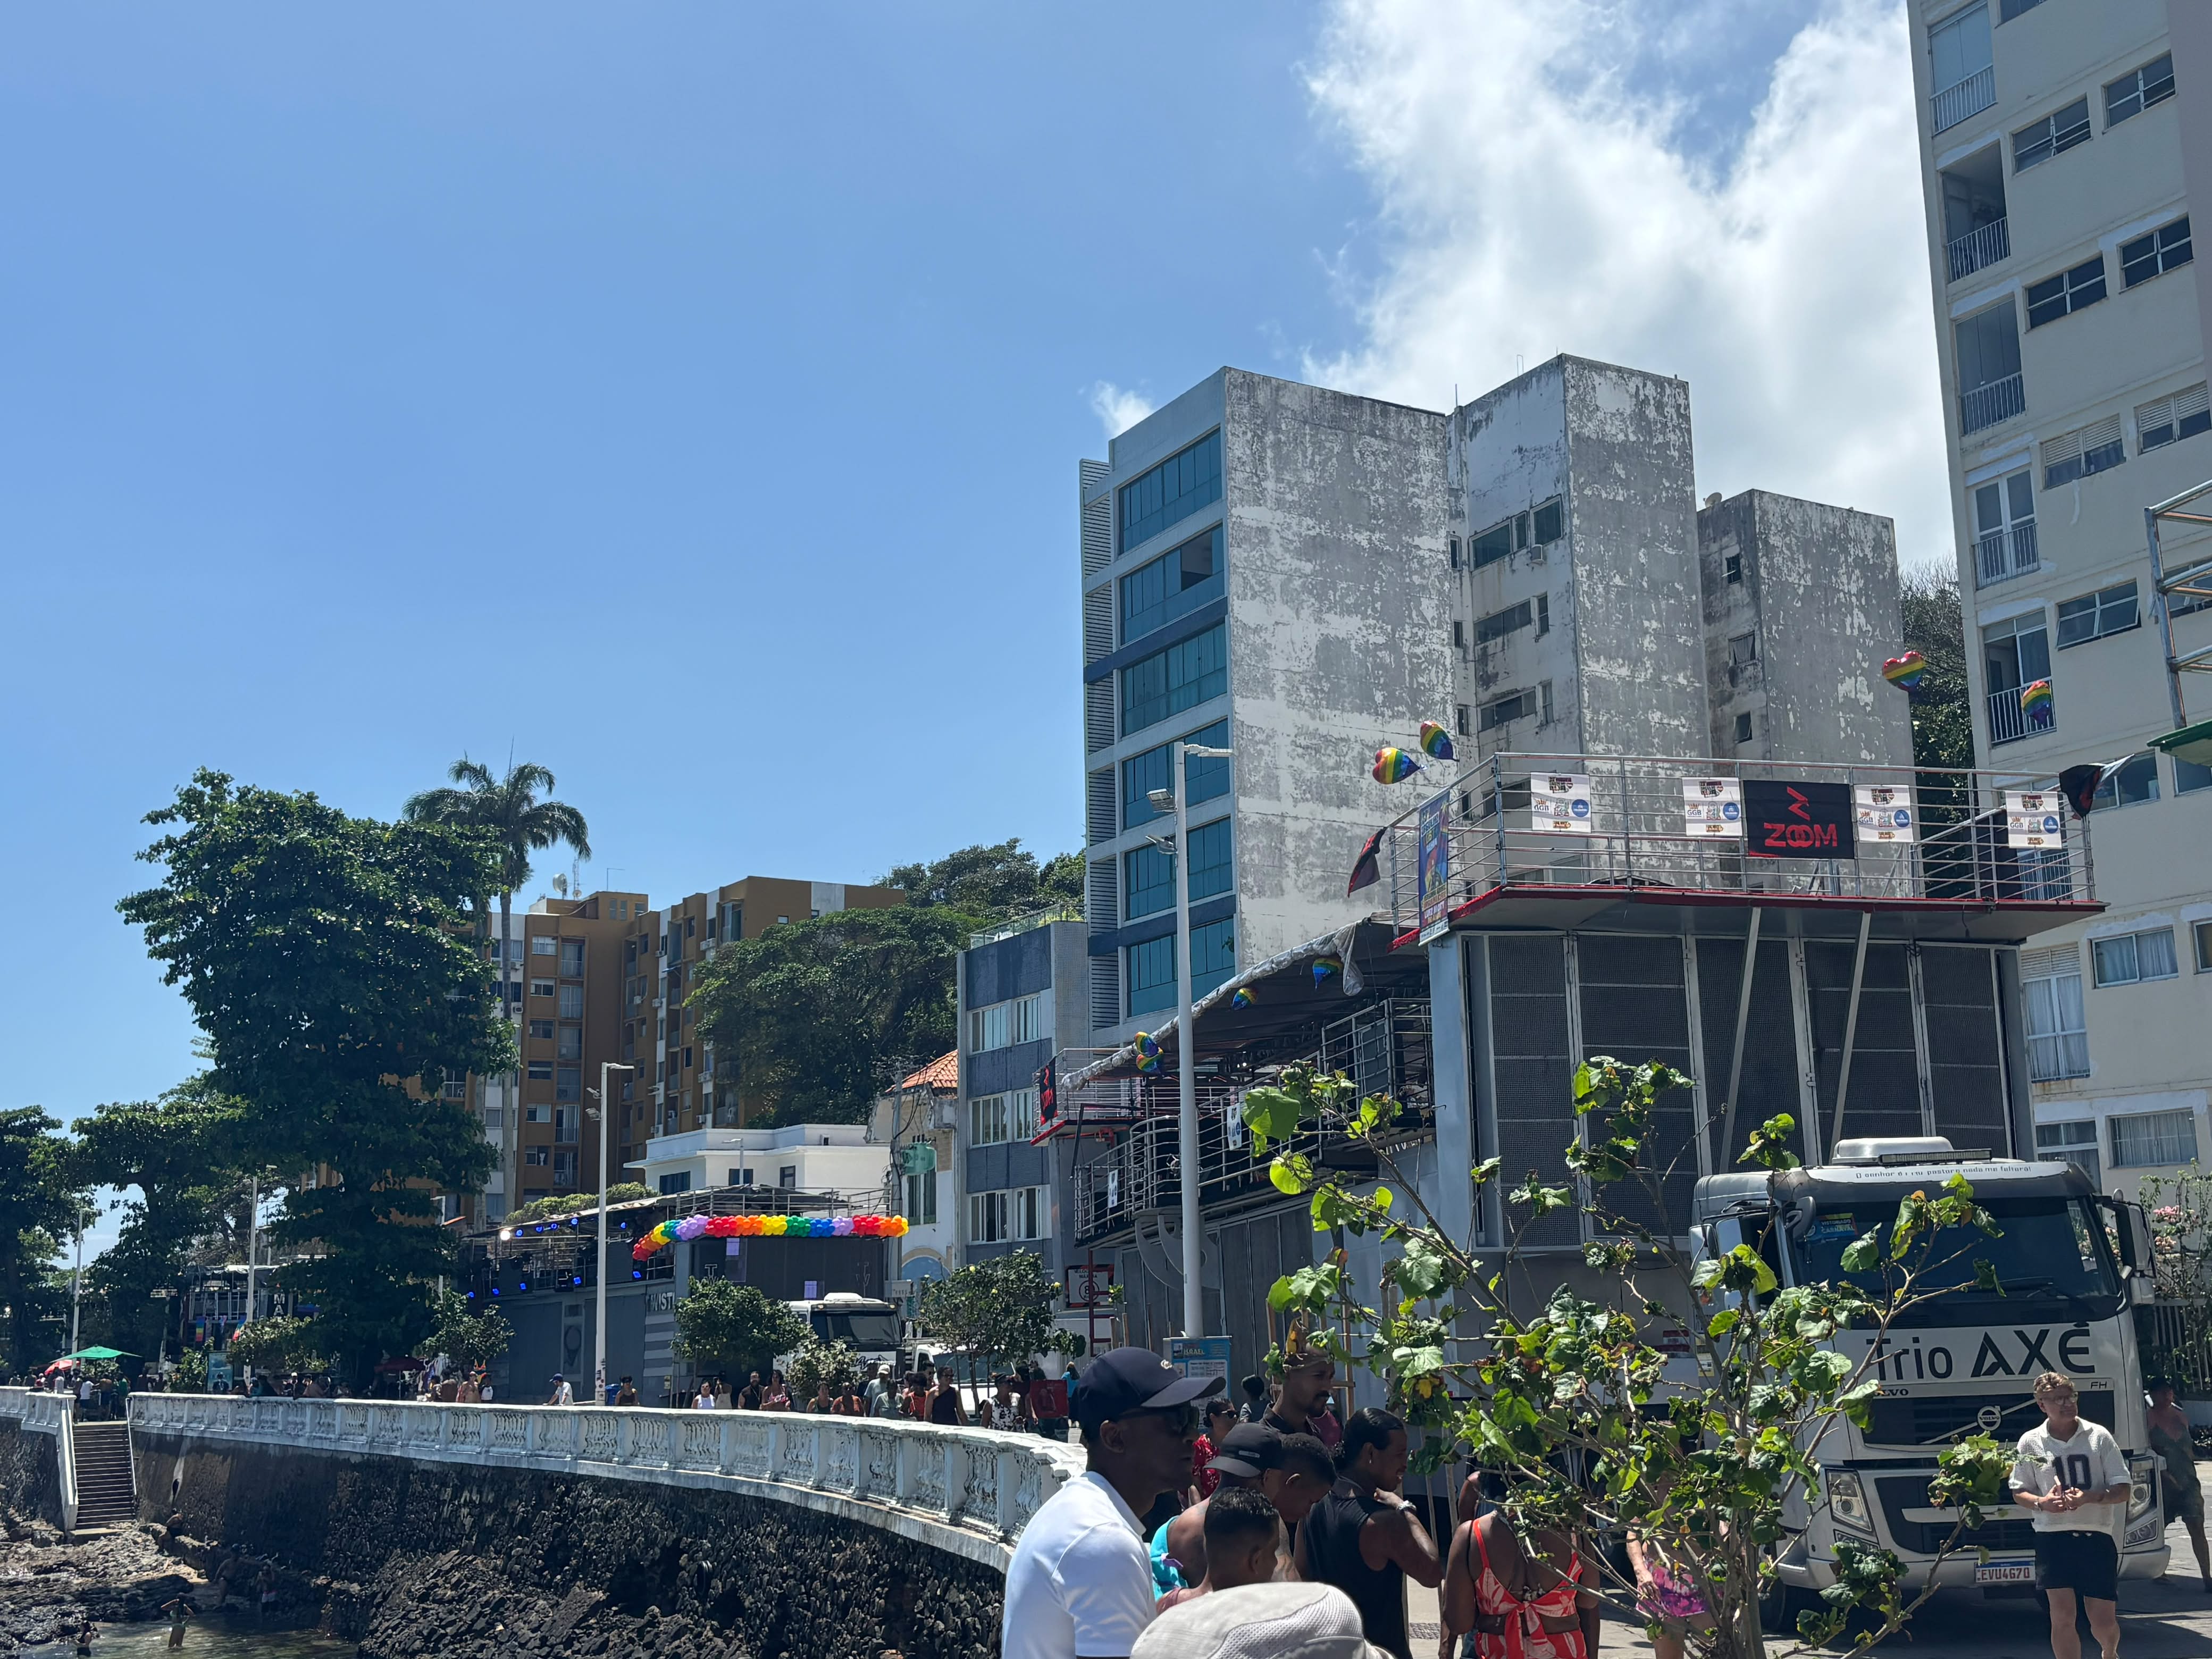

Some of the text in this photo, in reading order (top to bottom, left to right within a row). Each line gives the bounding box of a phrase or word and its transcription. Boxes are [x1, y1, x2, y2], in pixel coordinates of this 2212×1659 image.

[1764, 822, 1838, 848] ZOOM
[1866, 1337, 1953, 1381] Trio
[2052, 1454, 2092, 1491] 10
